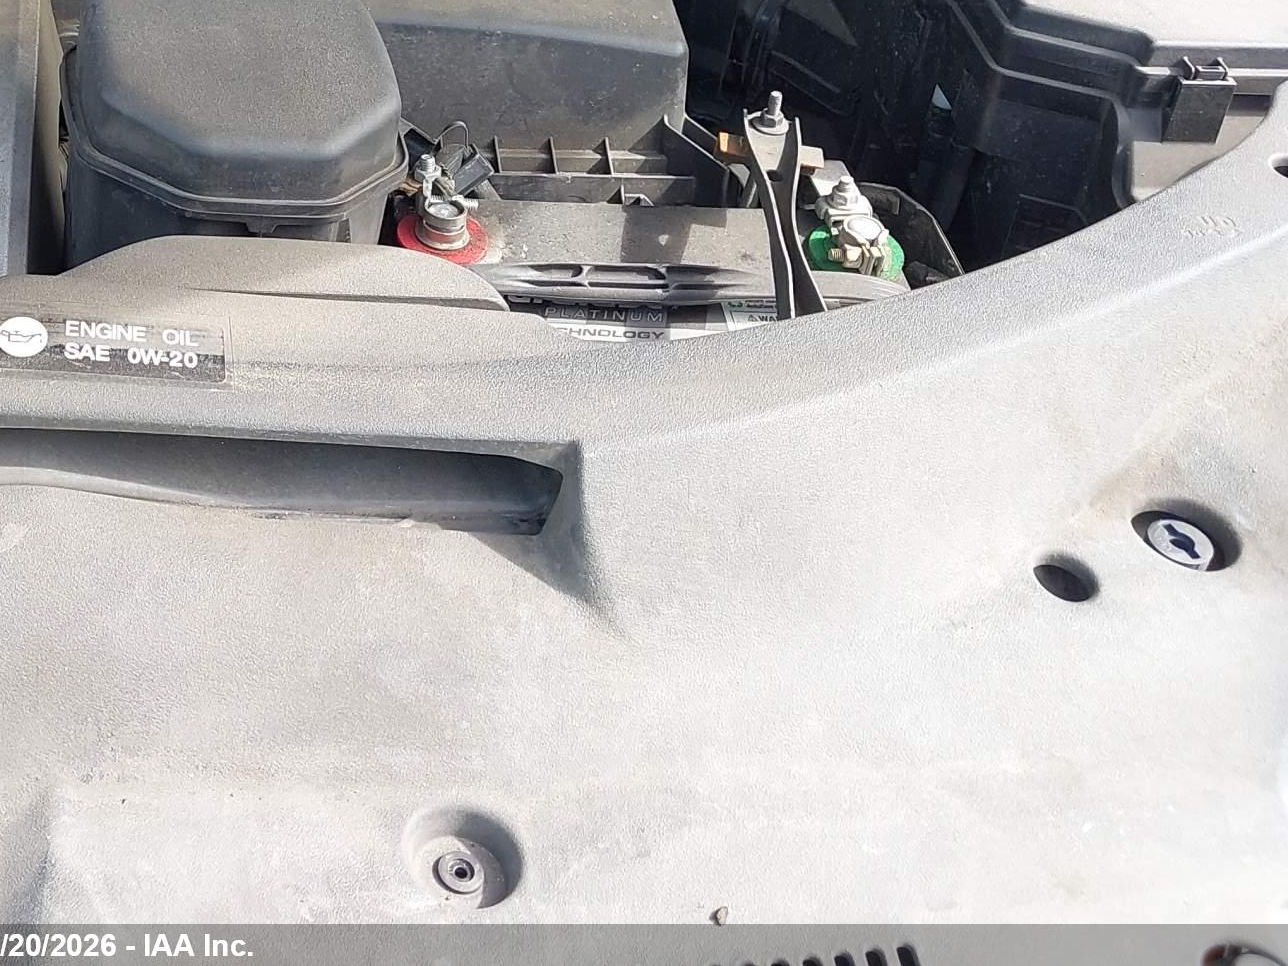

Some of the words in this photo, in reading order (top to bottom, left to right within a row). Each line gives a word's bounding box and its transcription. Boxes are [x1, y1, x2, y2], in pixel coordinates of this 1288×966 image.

[544, 306, 663, 323] PLATINUM
[64, 319, 147, 343] ENGINE
[162, 327, 200, 347] OIL
[557, 326, 665, 340] HNOLOGY
[64, 342, 111, 362] SAE
[127, 347, 199, 369] 0W-20
